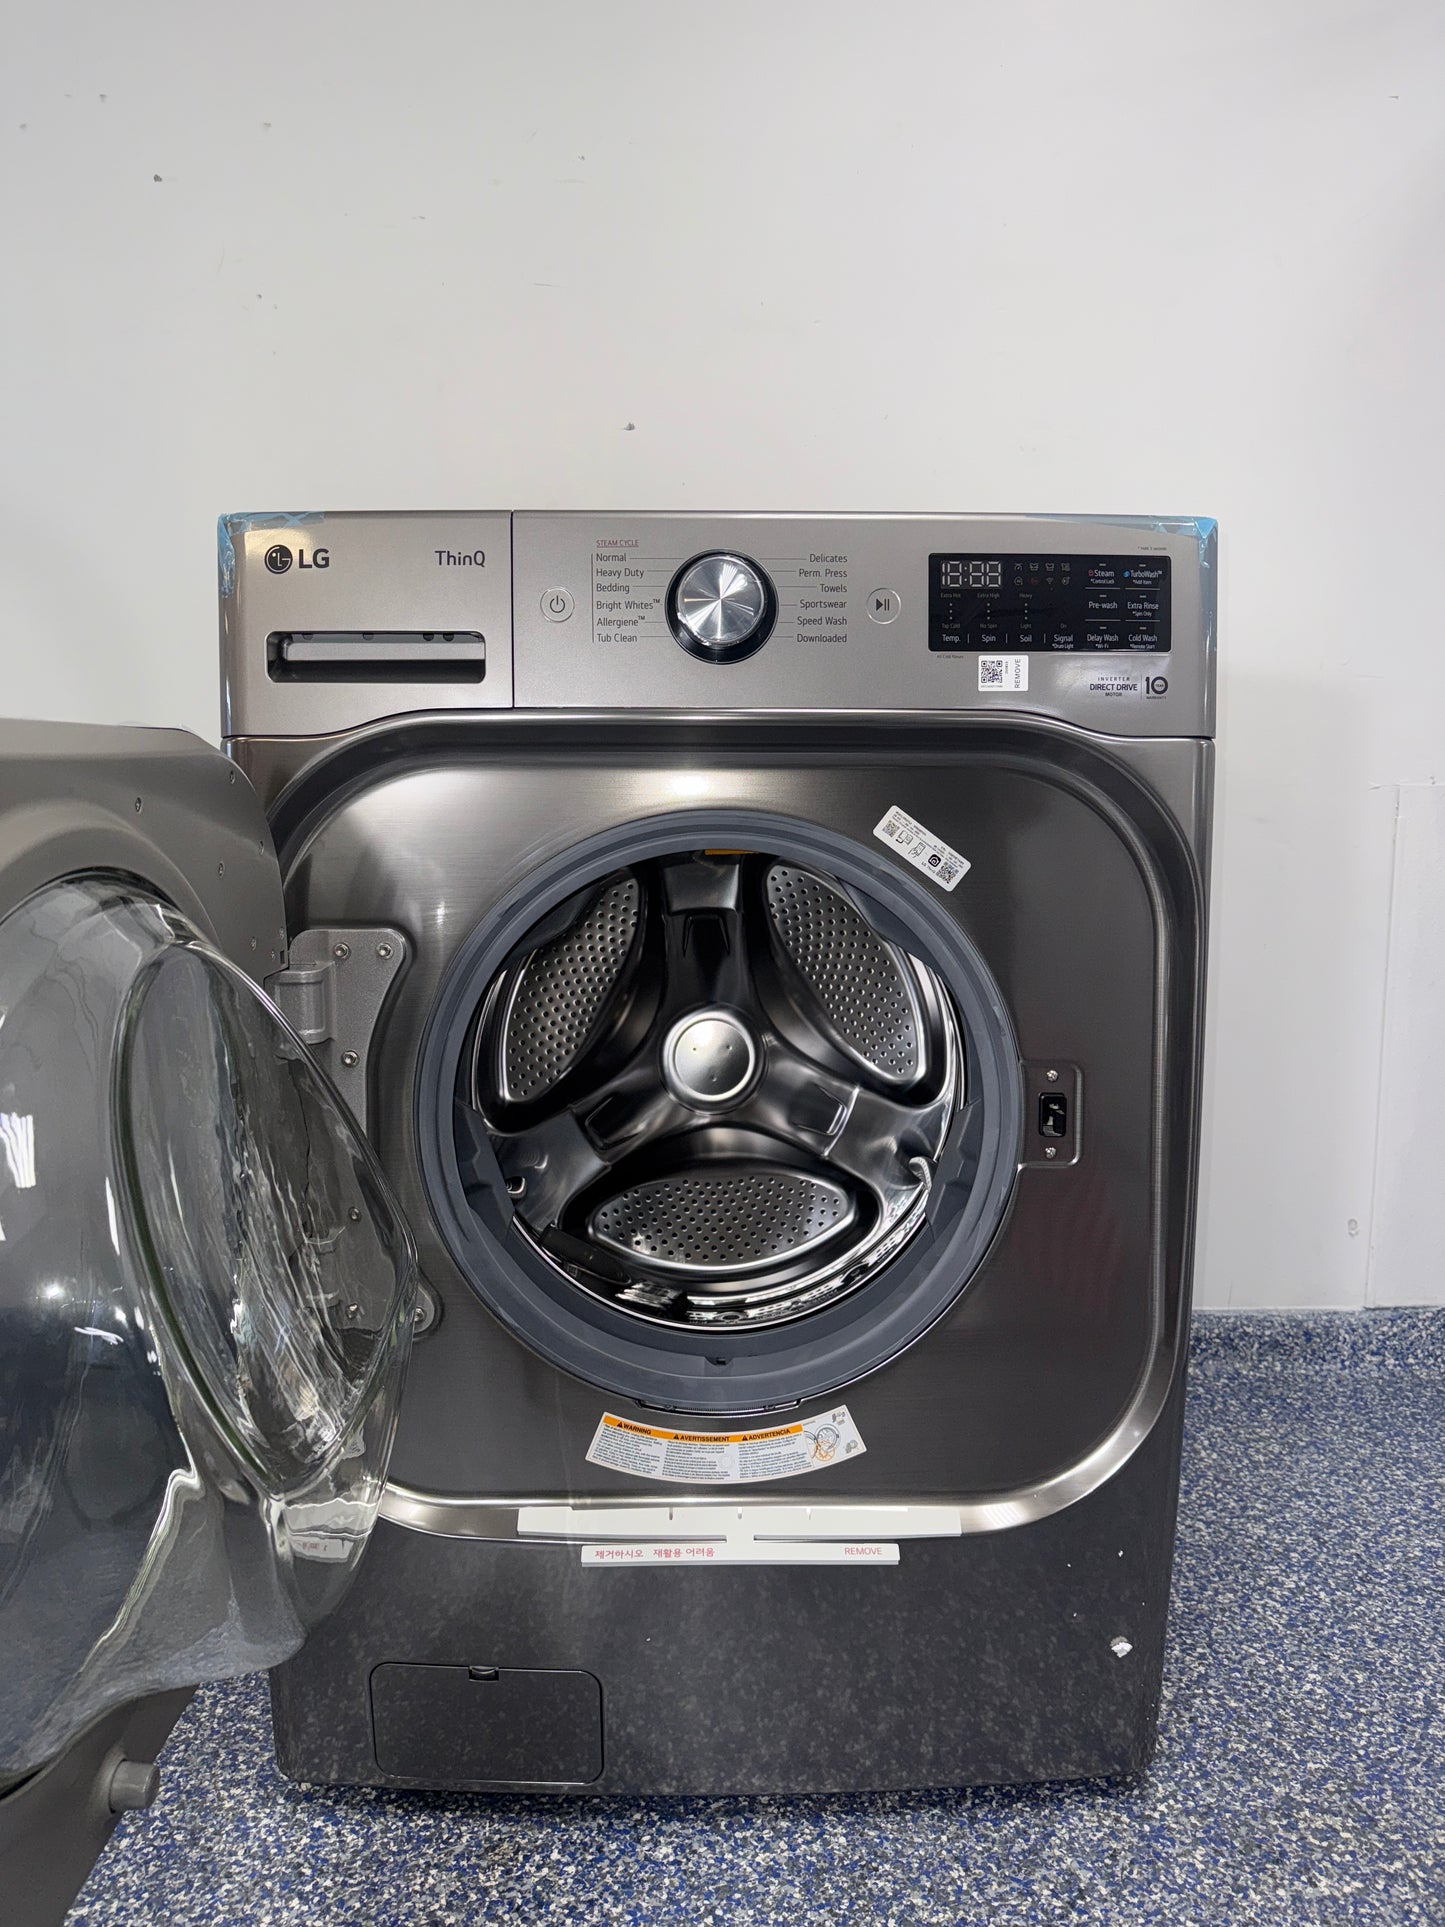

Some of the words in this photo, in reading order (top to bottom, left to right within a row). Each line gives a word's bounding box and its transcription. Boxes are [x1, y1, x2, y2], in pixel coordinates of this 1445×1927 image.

[596, 540, 618, 548] STEAM
[619, 540, 640, 548] CYCLE
[298, 548, 331, 569] LG
[434, 550, 486, 568] ThinQ
[596, 553, 627, 562] Normal
[809, 553, 848, 563] Delicates
[596, 567, 622, 579] Heavy
[624, 567, 645, 579] Duty
[798, 568, 822, 578] Perm.
[825, 568, 848, 578] Press
[1094, 569, 1115, 578] Steam
[596, 583, 630, 594] Bedding
[819, 583, 848, 593] Towels
[596, 600, 622, 612] Bright
[800, 598, 847, 610] Sportswear
[1088, 601, 1118, 609] Pre-wash
[1127, 601, 1143, 610] Extra
[1143, 601, 1159, 610] Rinse
[797, 615, 823, 626] Speed
[825, 616, 848, 626] Wash
[597, 633, 612, 643] Tub
[613, 633, 638, 643] Clean
[796, 633, 848, 643] Downloaded
[942, 634, 961, 643] Temp.
[981, 634, 997, 643] Spin
[1019, 634, 1033, 643] Soil
[1053, 634, 1074, 643] Signal
[1086, 634, 1103, 643] Delay
[1103, 634, 1119, 642] Wash
[1128, 634, 1142, 642] Cold
[1142, 634, 1158, 642] Wash
[1089, 683, 1115, 691] DIRECT
[1116, 683, 1138, 691] DRIVE
[1145, 676, 1169, 695] 10
[623, 1423, 652, 1435] WARNING
[680, 1434, 731, 1443] AVERTISSEMENT
[748, 1428, 791, 1441] ADVERTENCIA
[844, 1547, 882, 1556] REMOVE
